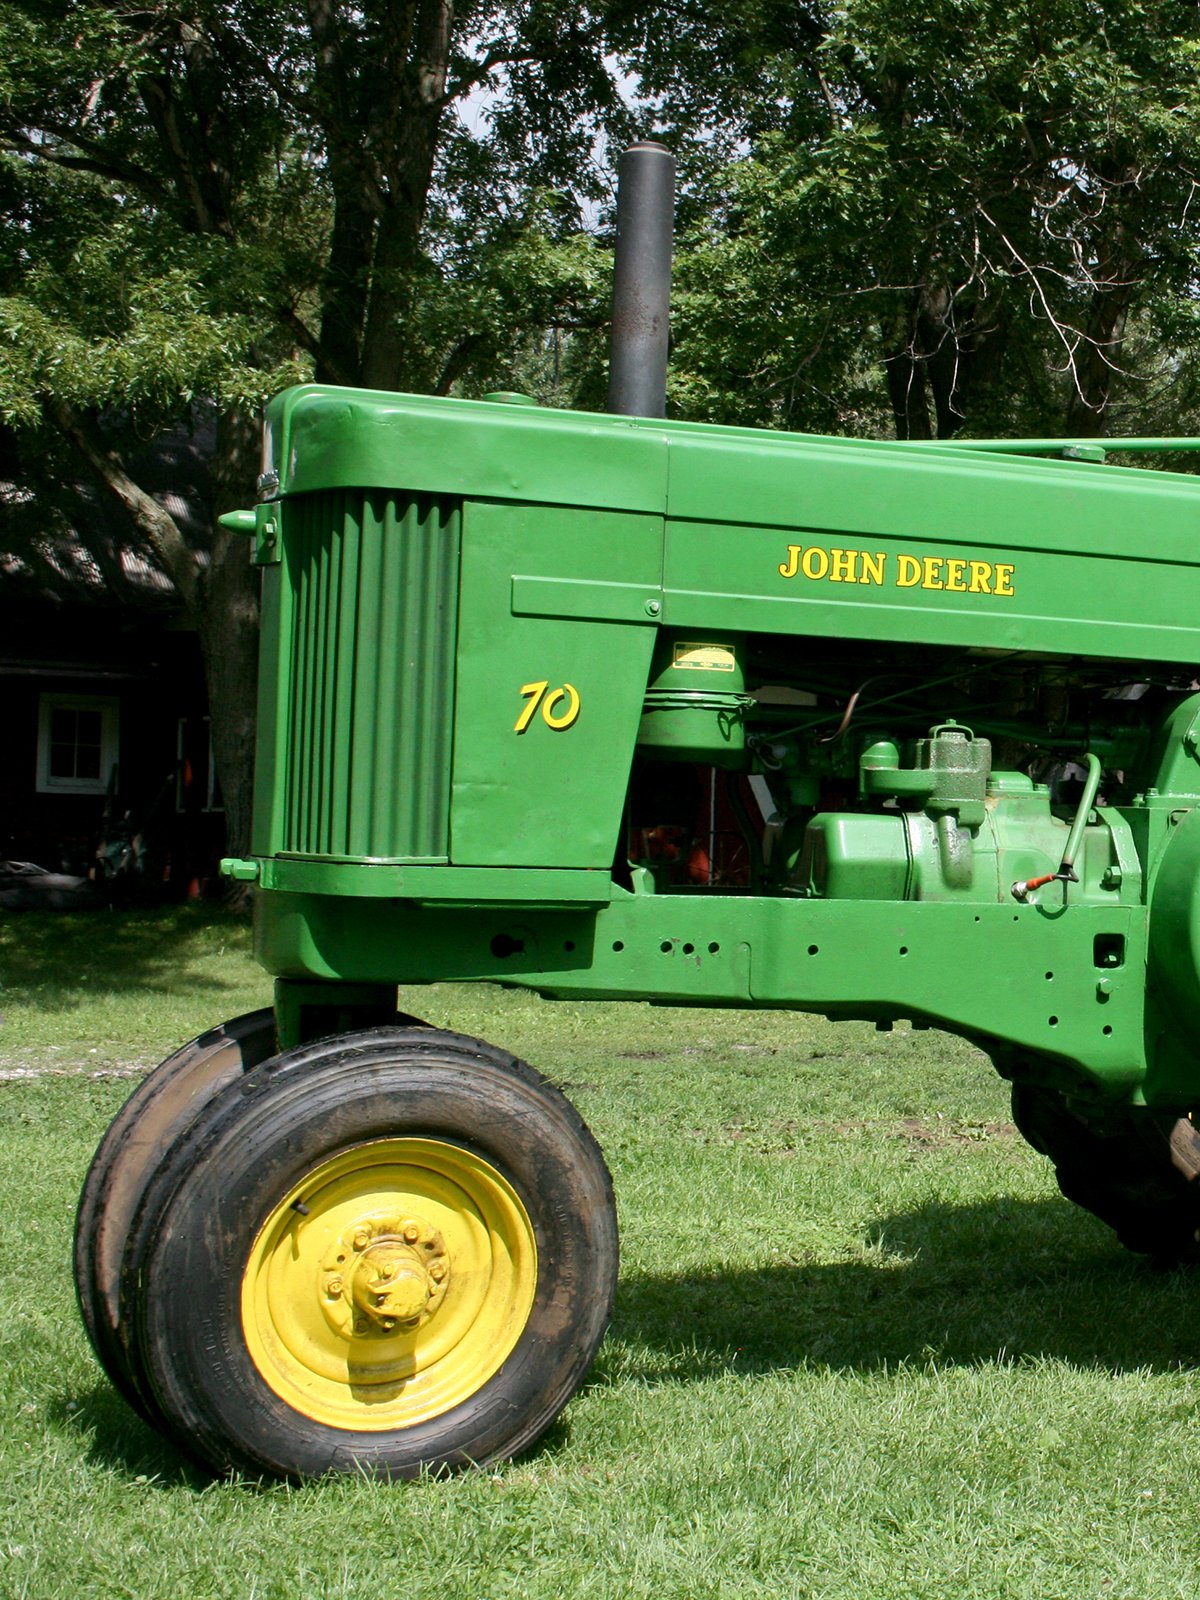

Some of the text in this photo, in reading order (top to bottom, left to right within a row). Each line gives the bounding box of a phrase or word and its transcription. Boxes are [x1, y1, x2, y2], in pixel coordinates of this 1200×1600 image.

[778, 545, 1015, 596] JOHN DEERE
[514, 680, 581, 736] 70
